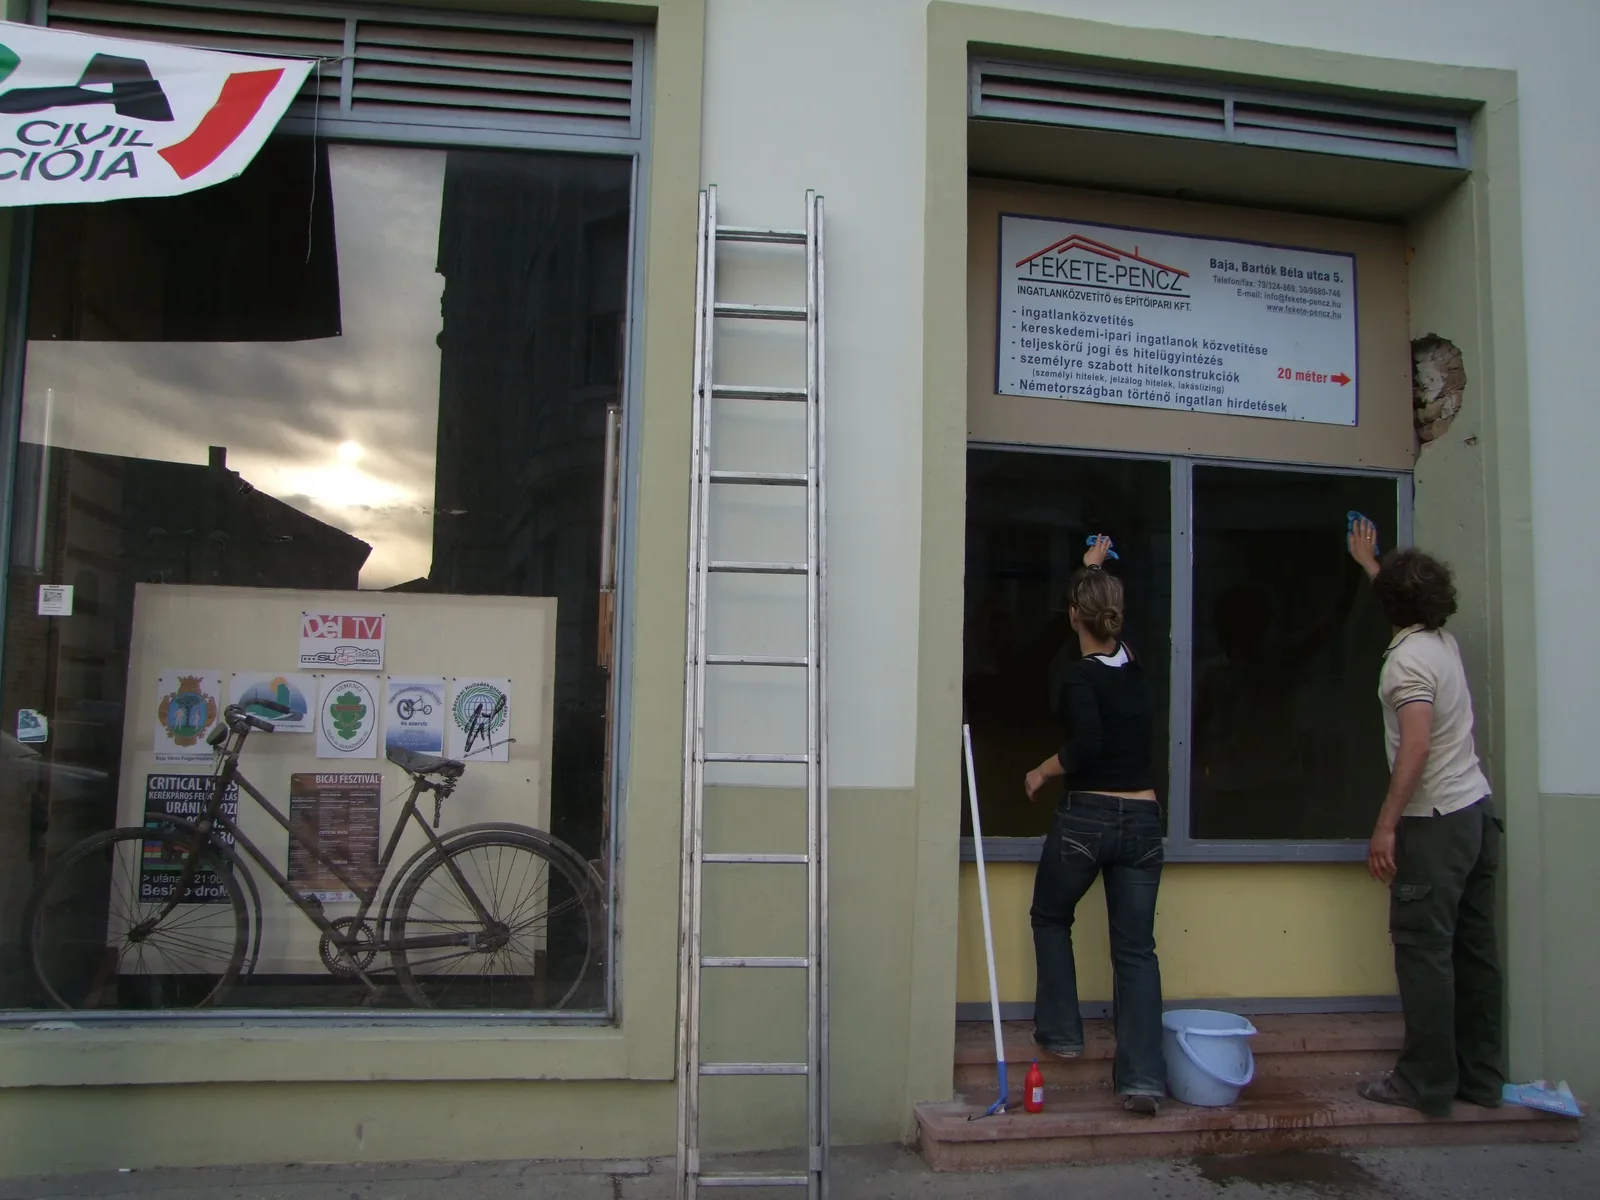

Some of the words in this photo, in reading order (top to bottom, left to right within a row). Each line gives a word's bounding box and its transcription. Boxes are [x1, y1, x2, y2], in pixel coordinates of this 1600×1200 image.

[16, 120, 154, 147] CIVIL
[0, 143, 139, 182] CIÓJA
[1029, 256, 1183, 291] FEKETE-PENCZ
[1209, 258, 1238, 272] Baja,
[1241, 261, 1277, 276] Bartók
[1280, 266, 1304, 279] Béla
[1306, 270, 1330, 282] utca
[1333, 272, 1344, 283] 5.
[1213, 275, 1256, 288] Telefon/fax:
[1017, 285, 1111, 304] INGATLANKÖZVETÍTŐ
[1113, 296, 1123, 305] és
[1174, 302, 1192, 312] KFT.
[1237, 288, 1263, 299] E-mail:
[1264, 291, 1342, 309] info@fekete-pencz.hu
[1021, 306, 1134, 327] ingatlanközvetítés
[1266, 304, 1342, 319] www.fekete-pencz.hu
[1021, 321, 1131, 342] kereskedemi-ipari
[1136, 332, 1199, 349] ingatlanok
[1202, 338, 1269, 356] közvetítése
[1020, 337, 1083, 353] teljeskörű
[1086, 342, 1110, 357] jogi
[1115, 345, 1129, 357] és
[1133, 347, 1224, 367] hitelügyintézés
[1020, 354, 1083, 370] személyre
[1087, 360, 1133, 373] szabott
[1137, 363, 1240, 384] hitelkonstrukciók
[1032, 368, 1073, 380] (személyi
[1076, 371, 1107, 383] hitelek,
[1109, 374, 1142, 387] jelzálog
[1145, 378, 1176, 389] hitelek,
[1277, 367, 1292, 380] 20
[1295, 371, 1328, 384] méter
[1019, 378, 1123, 399] Németországban
[1127, 388, 1171, 402] történő
[1175, 393, 1222, 408] ingatlan
[1227, 397, 1288, 413] hirdetések
[303, 615, 343, 639] Dél
[352, 617, 380, 639] TV
[149, 776, 203, 791] CRITICAL
[205, 777, 239, 792] MSS
[315, 774, 338, 784] BICAJ
[339, 772, 380, 784] FESZTIVÁL
[148, 790, 193, 800] KERÉKPÁROS
